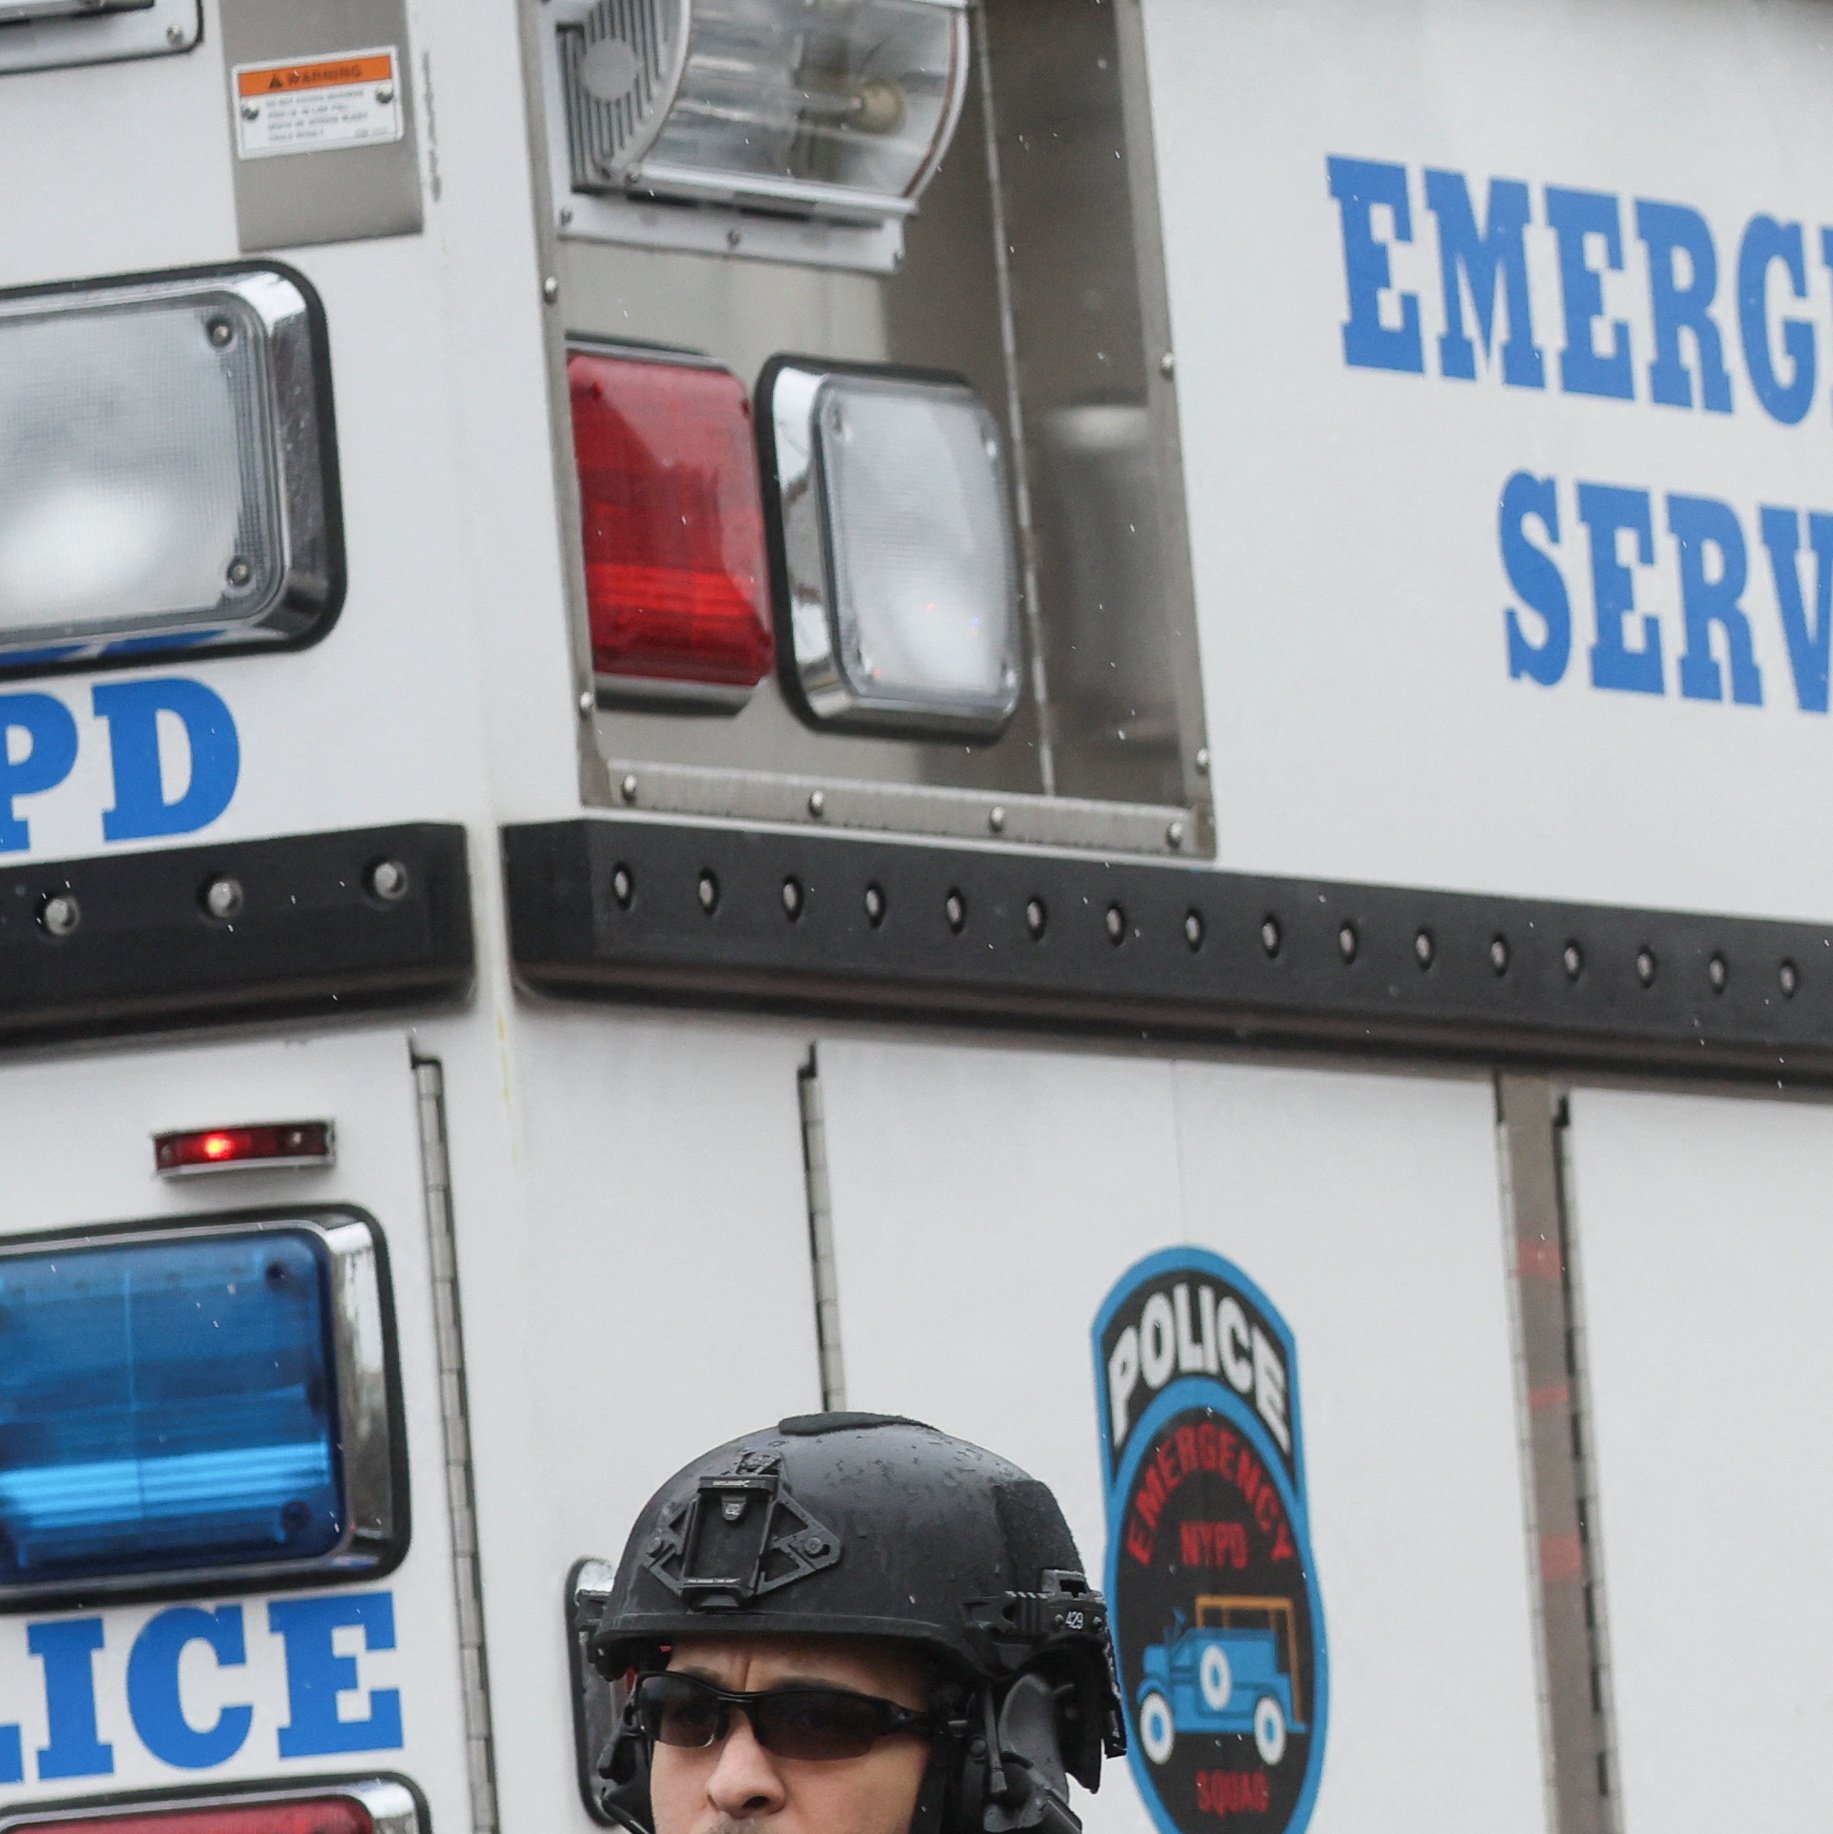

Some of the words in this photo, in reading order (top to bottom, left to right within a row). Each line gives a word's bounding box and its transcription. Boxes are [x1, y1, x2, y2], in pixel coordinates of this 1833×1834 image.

[1106, 1281, 1292, 1455] POLICE
[1128, 1422, 1293, 1566] EMERGENCY
[1178, 1520, 1249, 1569] NYPD
[0, 1592, 403, 1784] ICE
